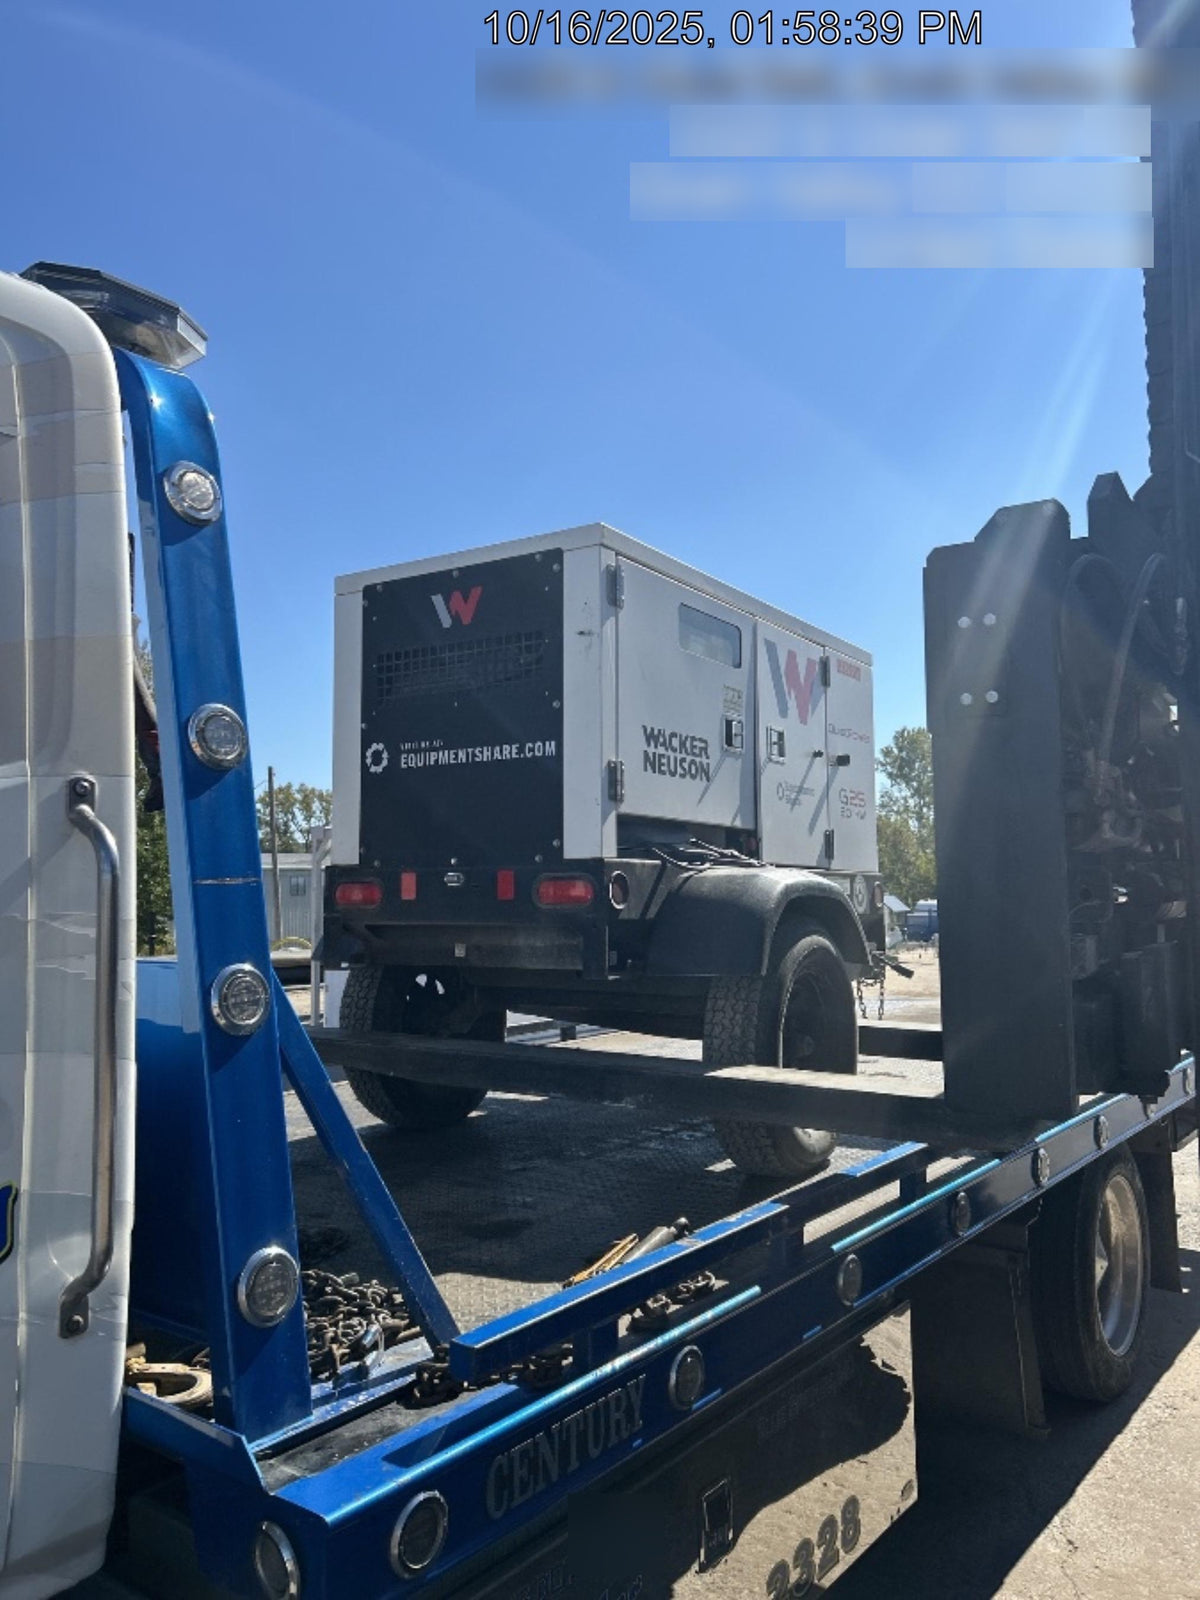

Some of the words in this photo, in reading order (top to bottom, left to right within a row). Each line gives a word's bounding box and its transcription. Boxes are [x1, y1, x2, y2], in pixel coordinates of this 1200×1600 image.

[401, 741, 556, 769] EQUIPMENTSHARE.COM
[641, 724, 710, 760] WACKER
[643, 750, 710, 783] NEUSON
[486, 1373, 647, 1520] CENTURY
